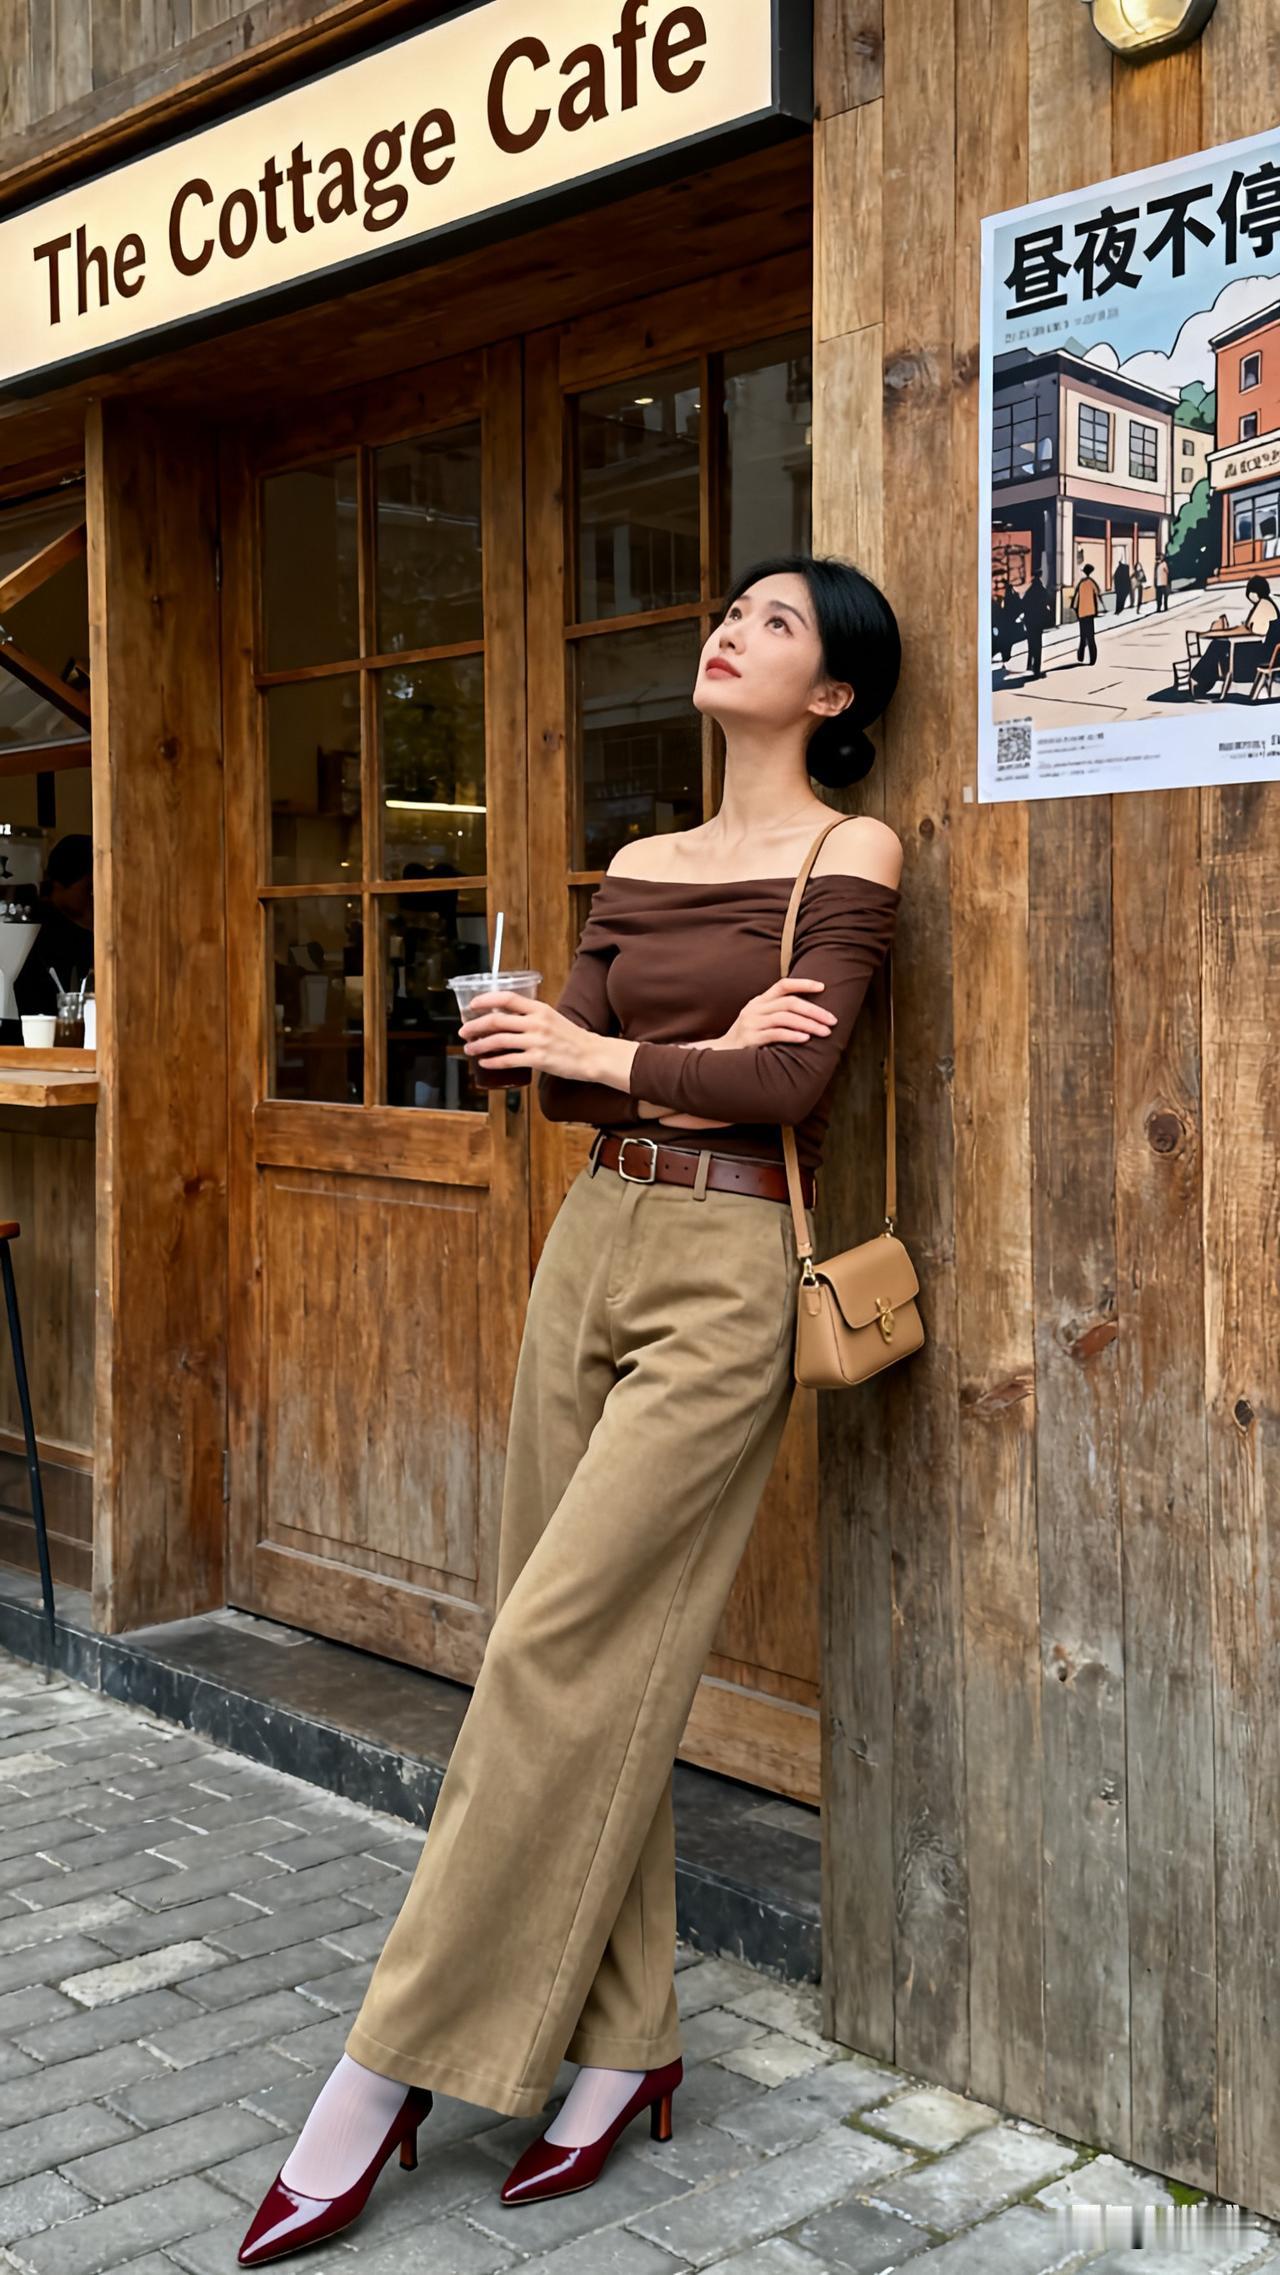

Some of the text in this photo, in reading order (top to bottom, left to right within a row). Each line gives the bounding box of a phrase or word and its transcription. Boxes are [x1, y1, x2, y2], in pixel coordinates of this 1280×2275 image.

[33, 0, 707, 326] The Cottage Cafe
[1003, 161, 1280, 320] 昼夜不停
